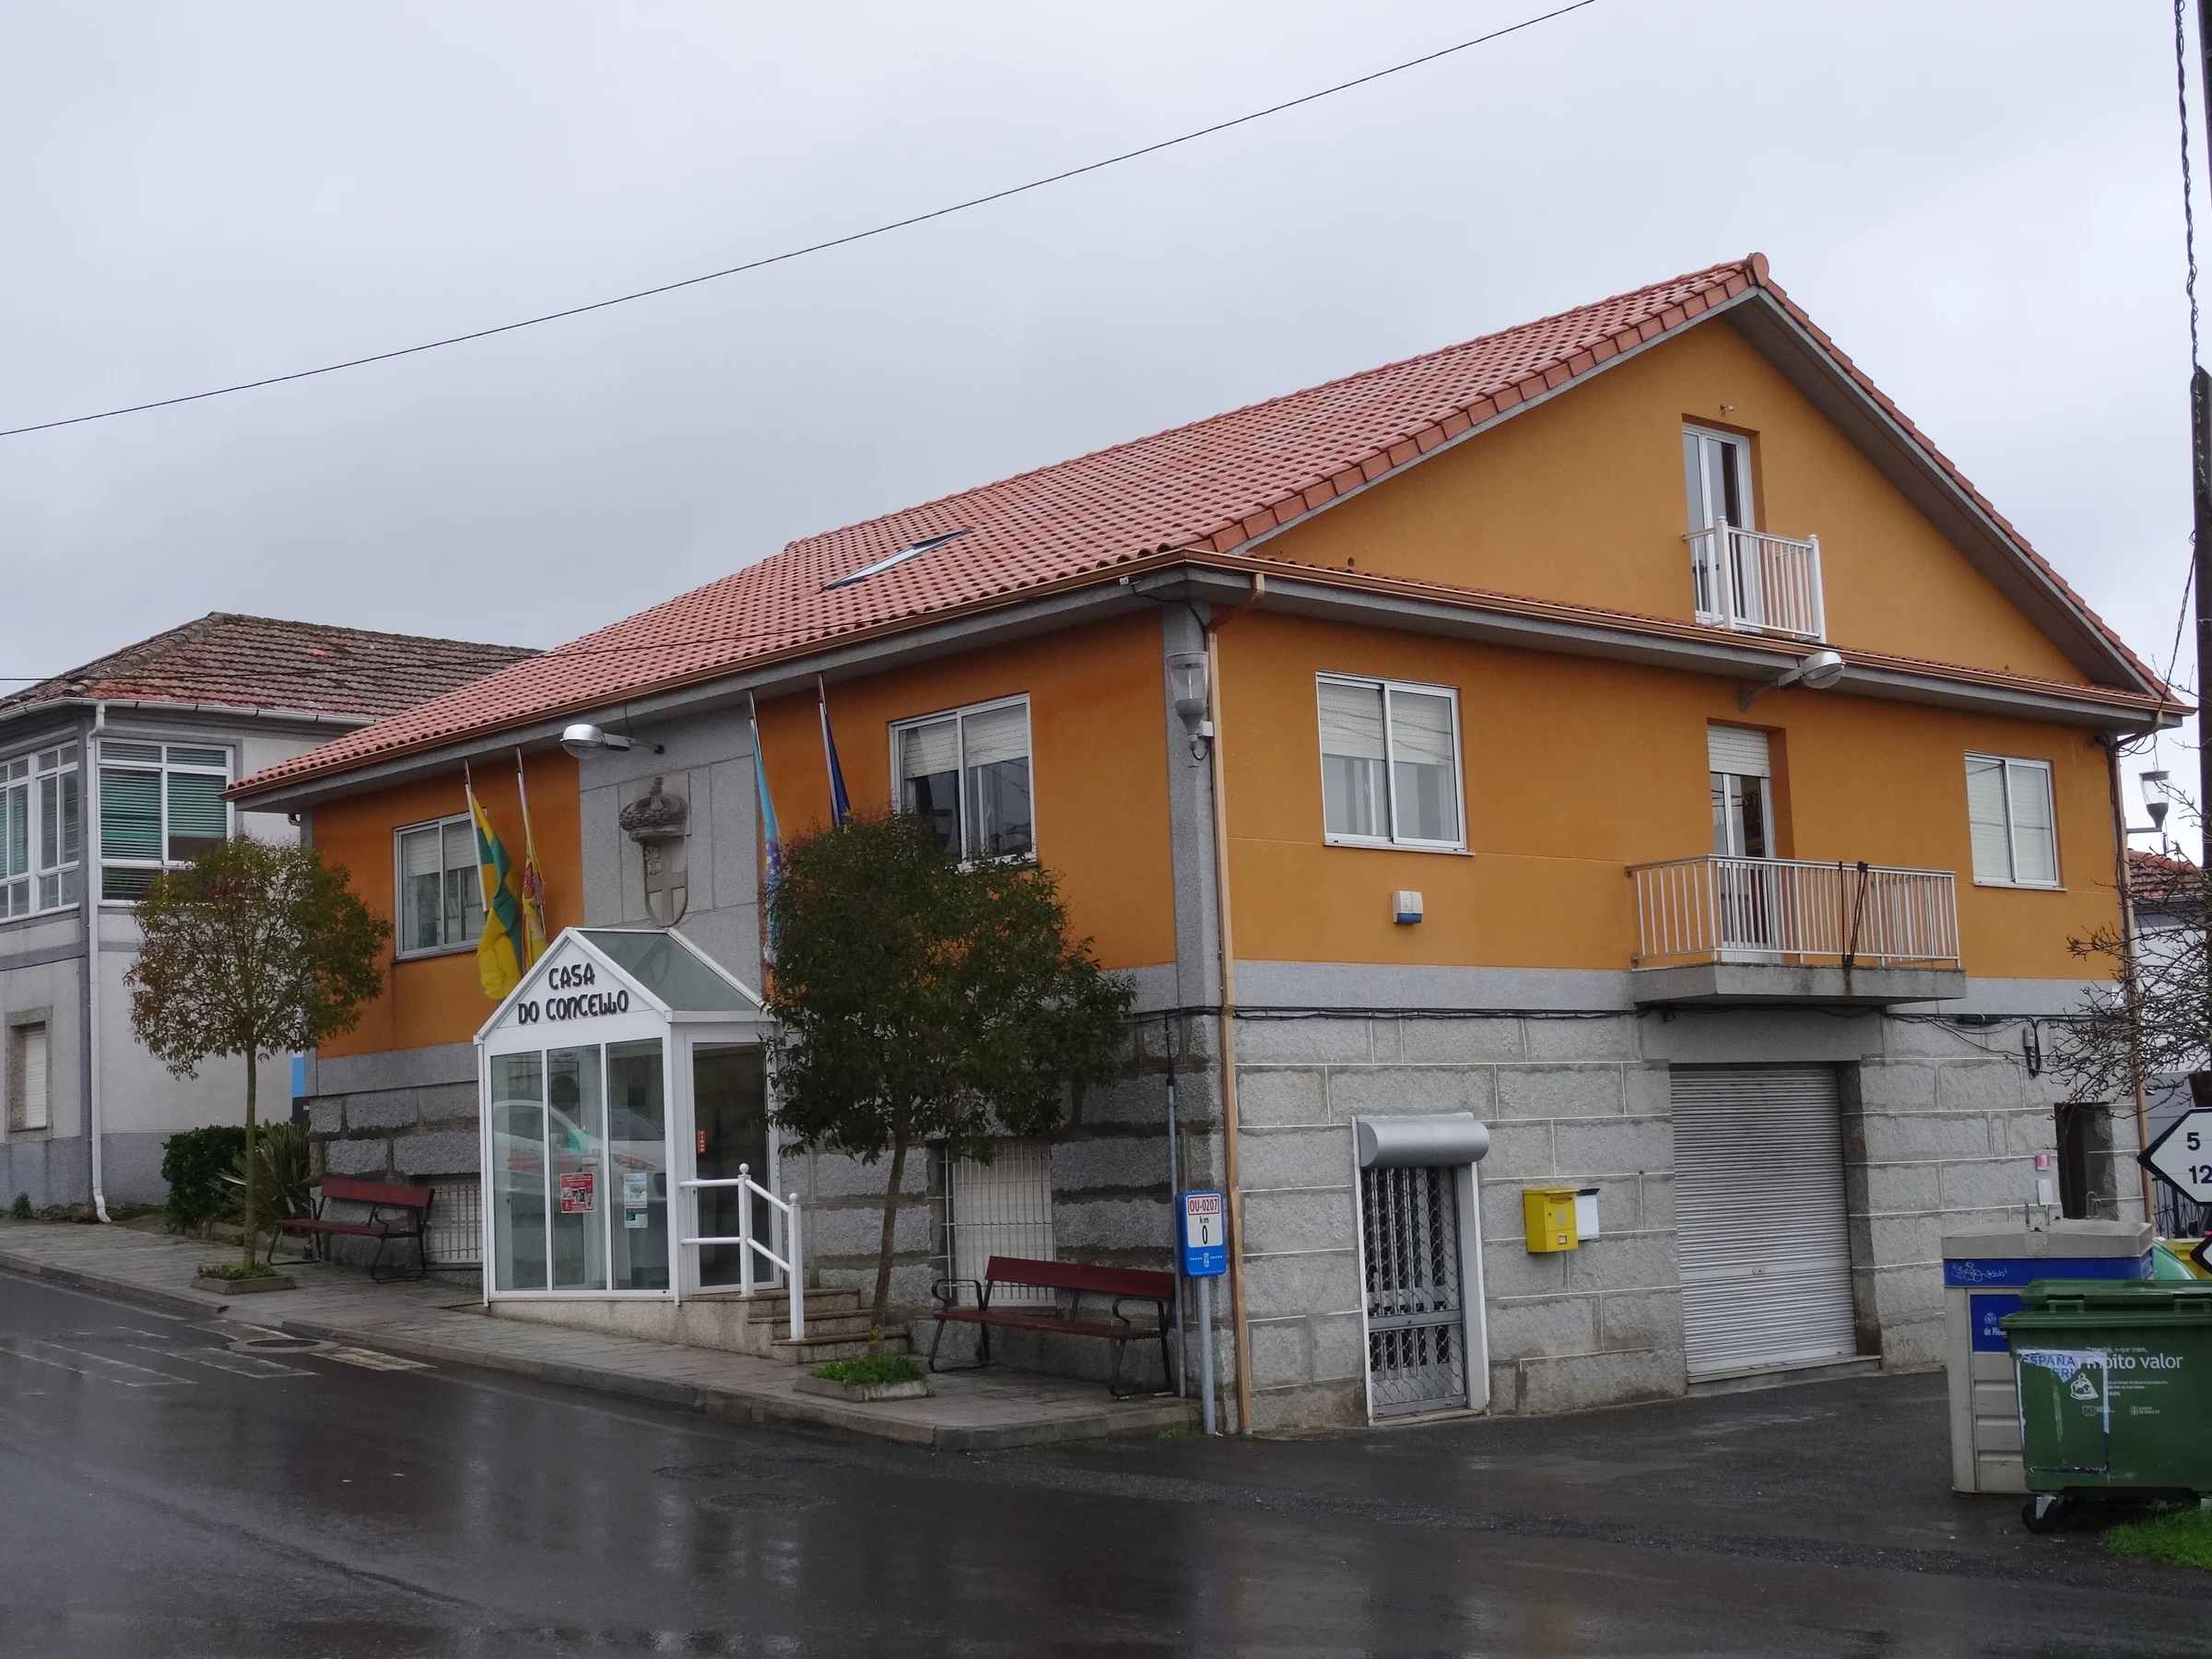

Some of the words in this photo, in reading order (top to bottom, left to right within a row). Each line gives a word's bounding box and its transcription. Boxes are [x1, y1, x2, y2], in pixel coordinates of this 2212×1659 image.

[548, 962, 595, 990] CASA
[518, 1000, 539, 1024] DO
[546, 990, 629, 1021] CONCELLO
[2186, 1132, 2201, 1151] 5
[2188, 1164, 2212, 1184] 12
[1189, 1199, 1218, 1212] OU-0207
[1199, 1216, 1209, 1224] km
[1202, 1225, 1208, 1245] 0
[2140, 1352, 2183, 1370] valor
